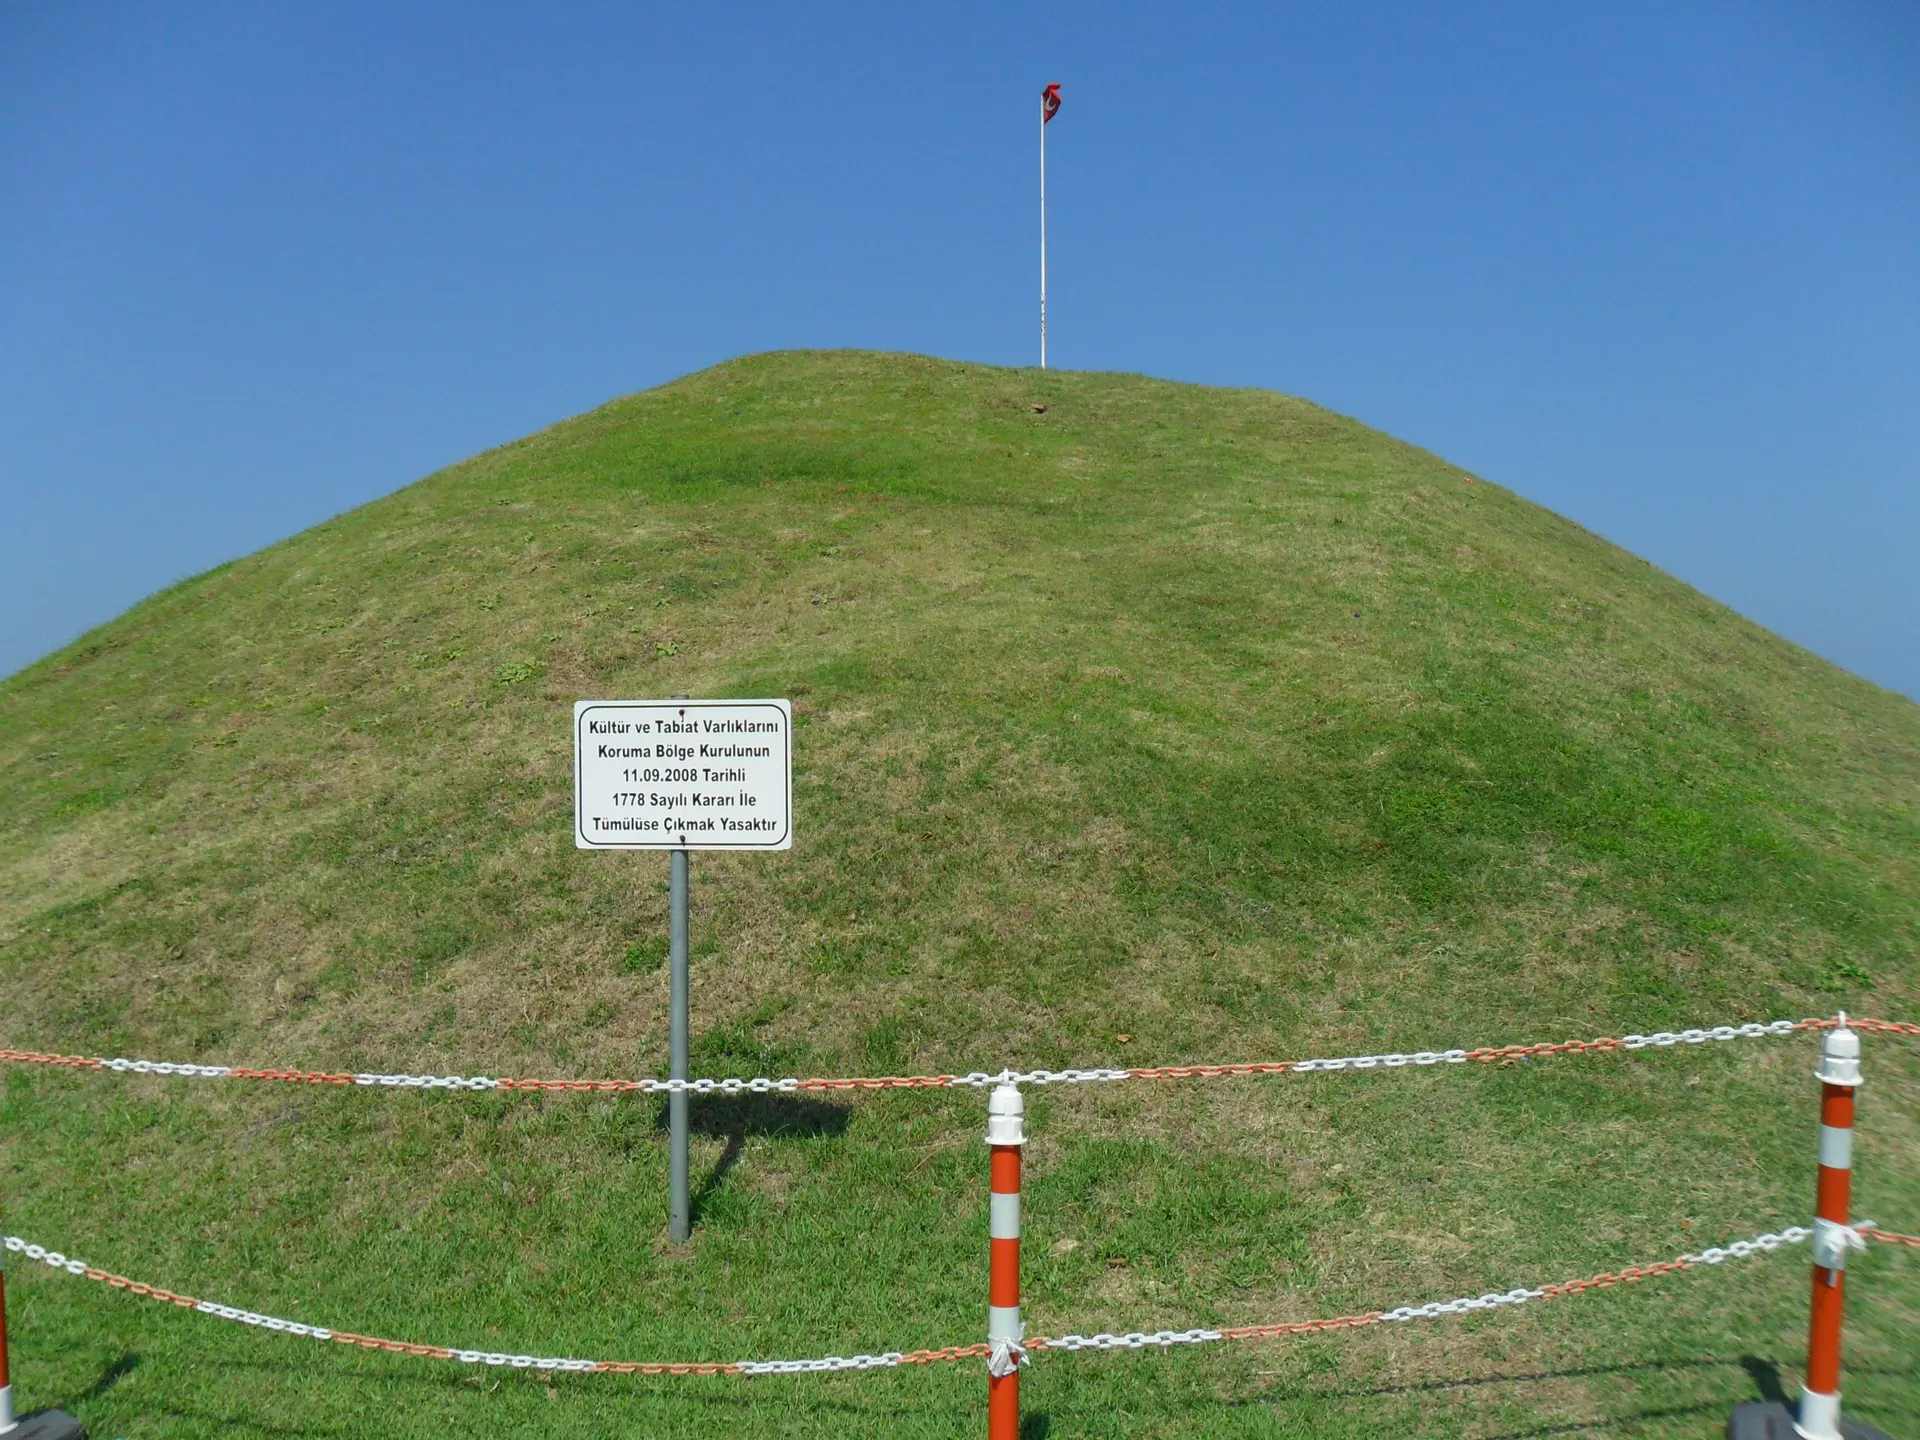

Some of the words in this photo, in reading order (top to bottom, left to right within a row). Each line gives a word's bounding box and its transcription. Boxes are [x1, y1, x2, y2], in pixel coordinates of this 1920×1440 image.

[590, 720, 631, 734] Kültür
[636, 723, 651, 734] ve
[656, 720, 699, 734] Tabiat
[703, 720, 778, 733] Varlıklarını
[598, 745, 651, 758] Koruma
[656, 744, 694, 761] Bölge
[700, 744, 770, 757] Kurulunun
[623, 768, 697, 782] 11.09.2008
[703, 768, 746, 782] Tarihli
[613, 793, 645, 806] 1778
[650, 793, 687, 809] Sayılı
[693, 793, 734, 806] Kararı
[740, 790, 756, 806] İle
[593, 817, 659, 831] Tümülüse
[664, 817, 715, 834] Çıkmak
[720, 817, 777, 831] Yasaktır
